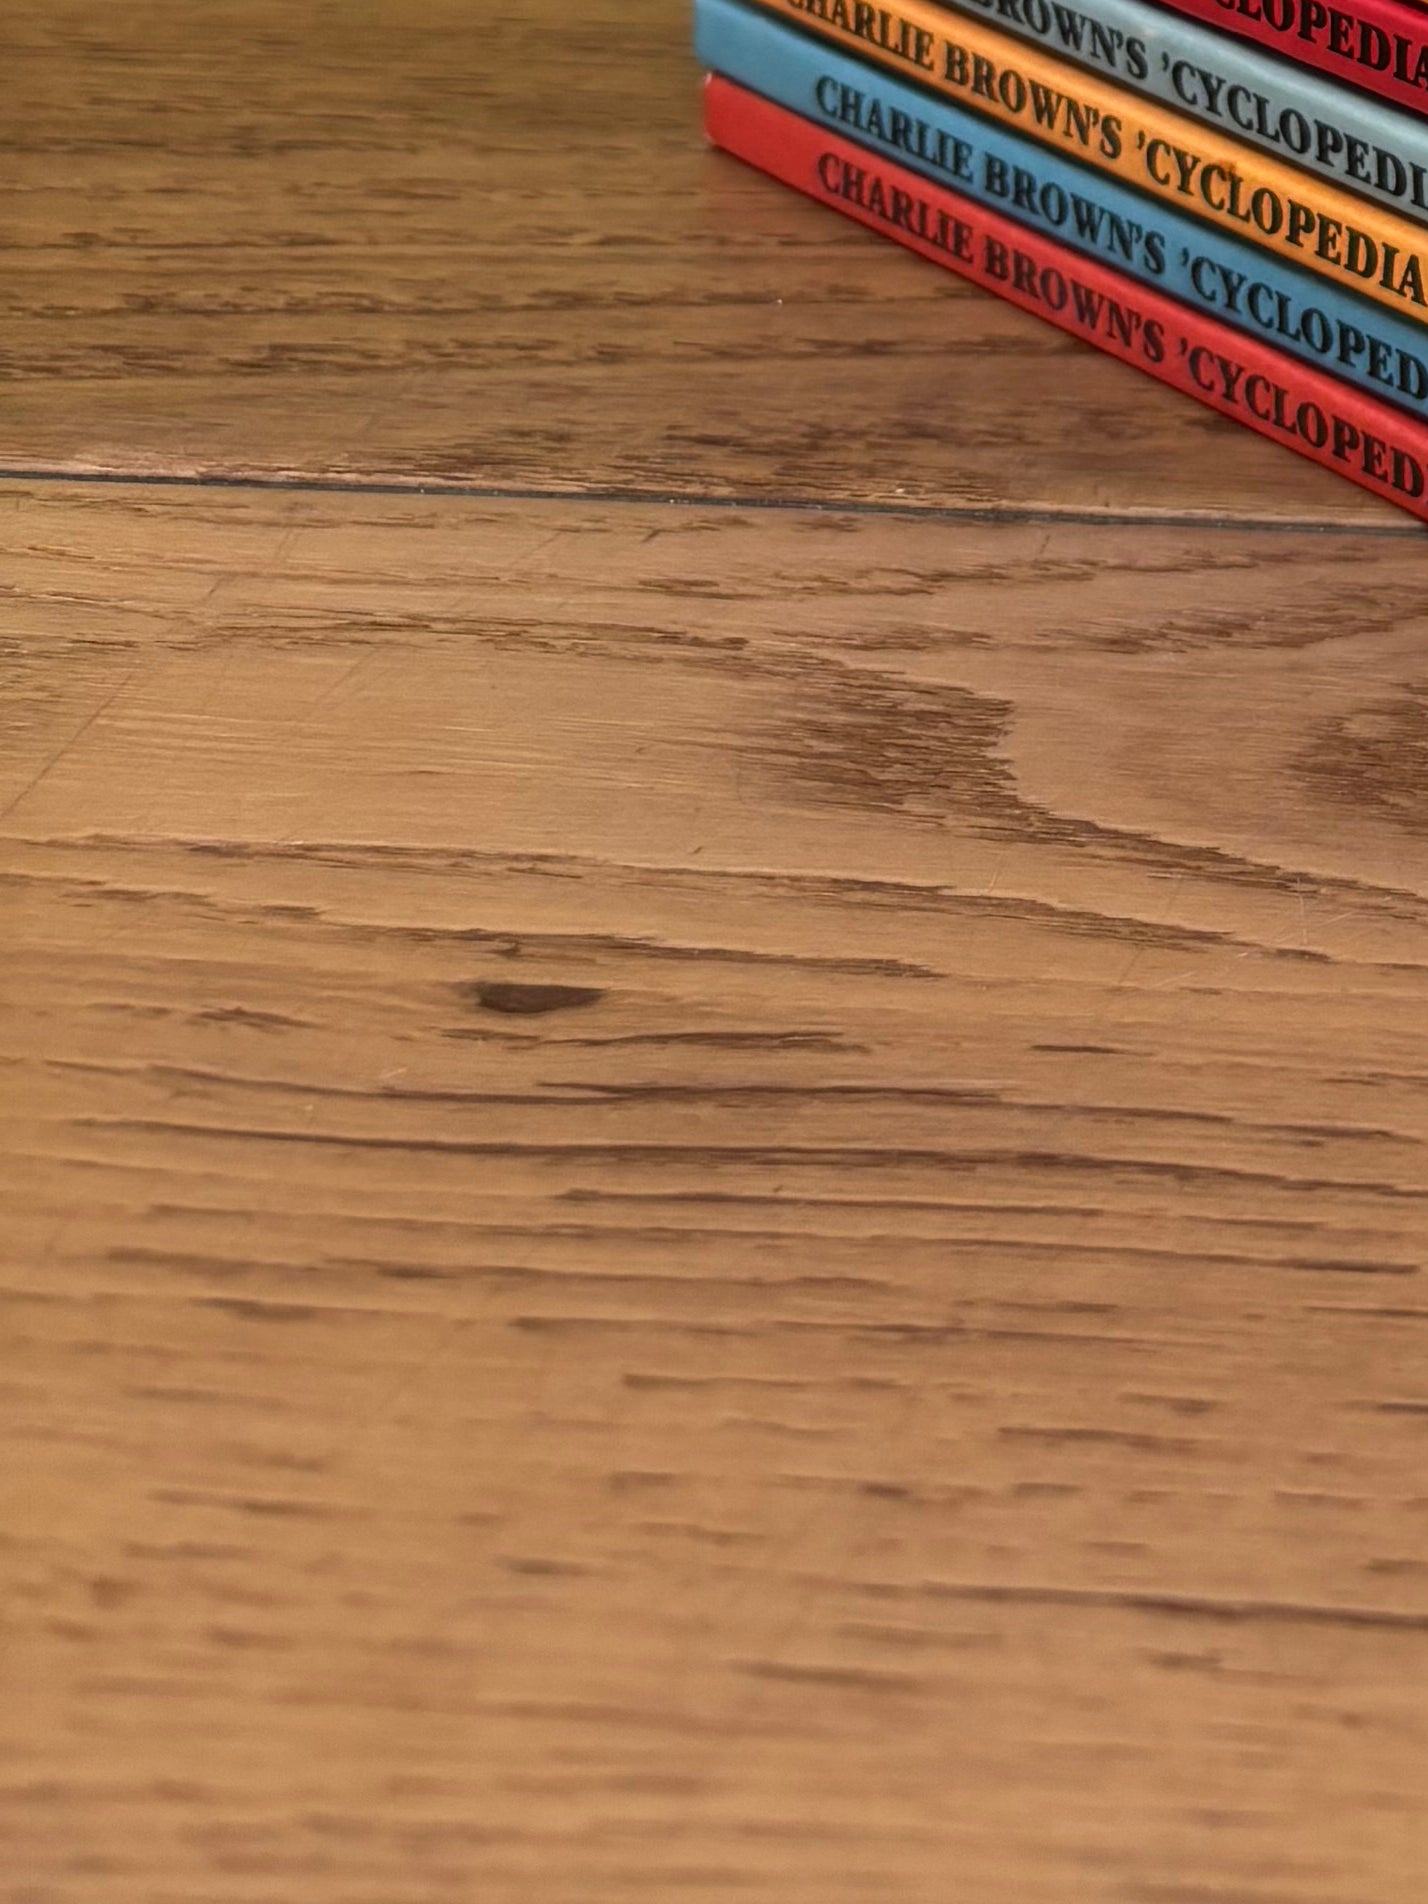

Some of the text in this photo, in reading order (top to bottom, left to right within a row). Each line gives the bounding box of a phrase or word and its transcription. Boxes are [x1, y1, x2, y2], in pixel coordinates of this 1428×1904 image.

[815, 77, 973, 183] CHARLIE
[984, 154, 1165, 276] BROWN'S
[816, 151, 975, 264] CHARLIE
[983, 235, 1167, 365] BROWN'S
[944, 43, 1121, 160] BROWN'S
[1137, 132, 1427, 307] 'CYCLOPEDIA
